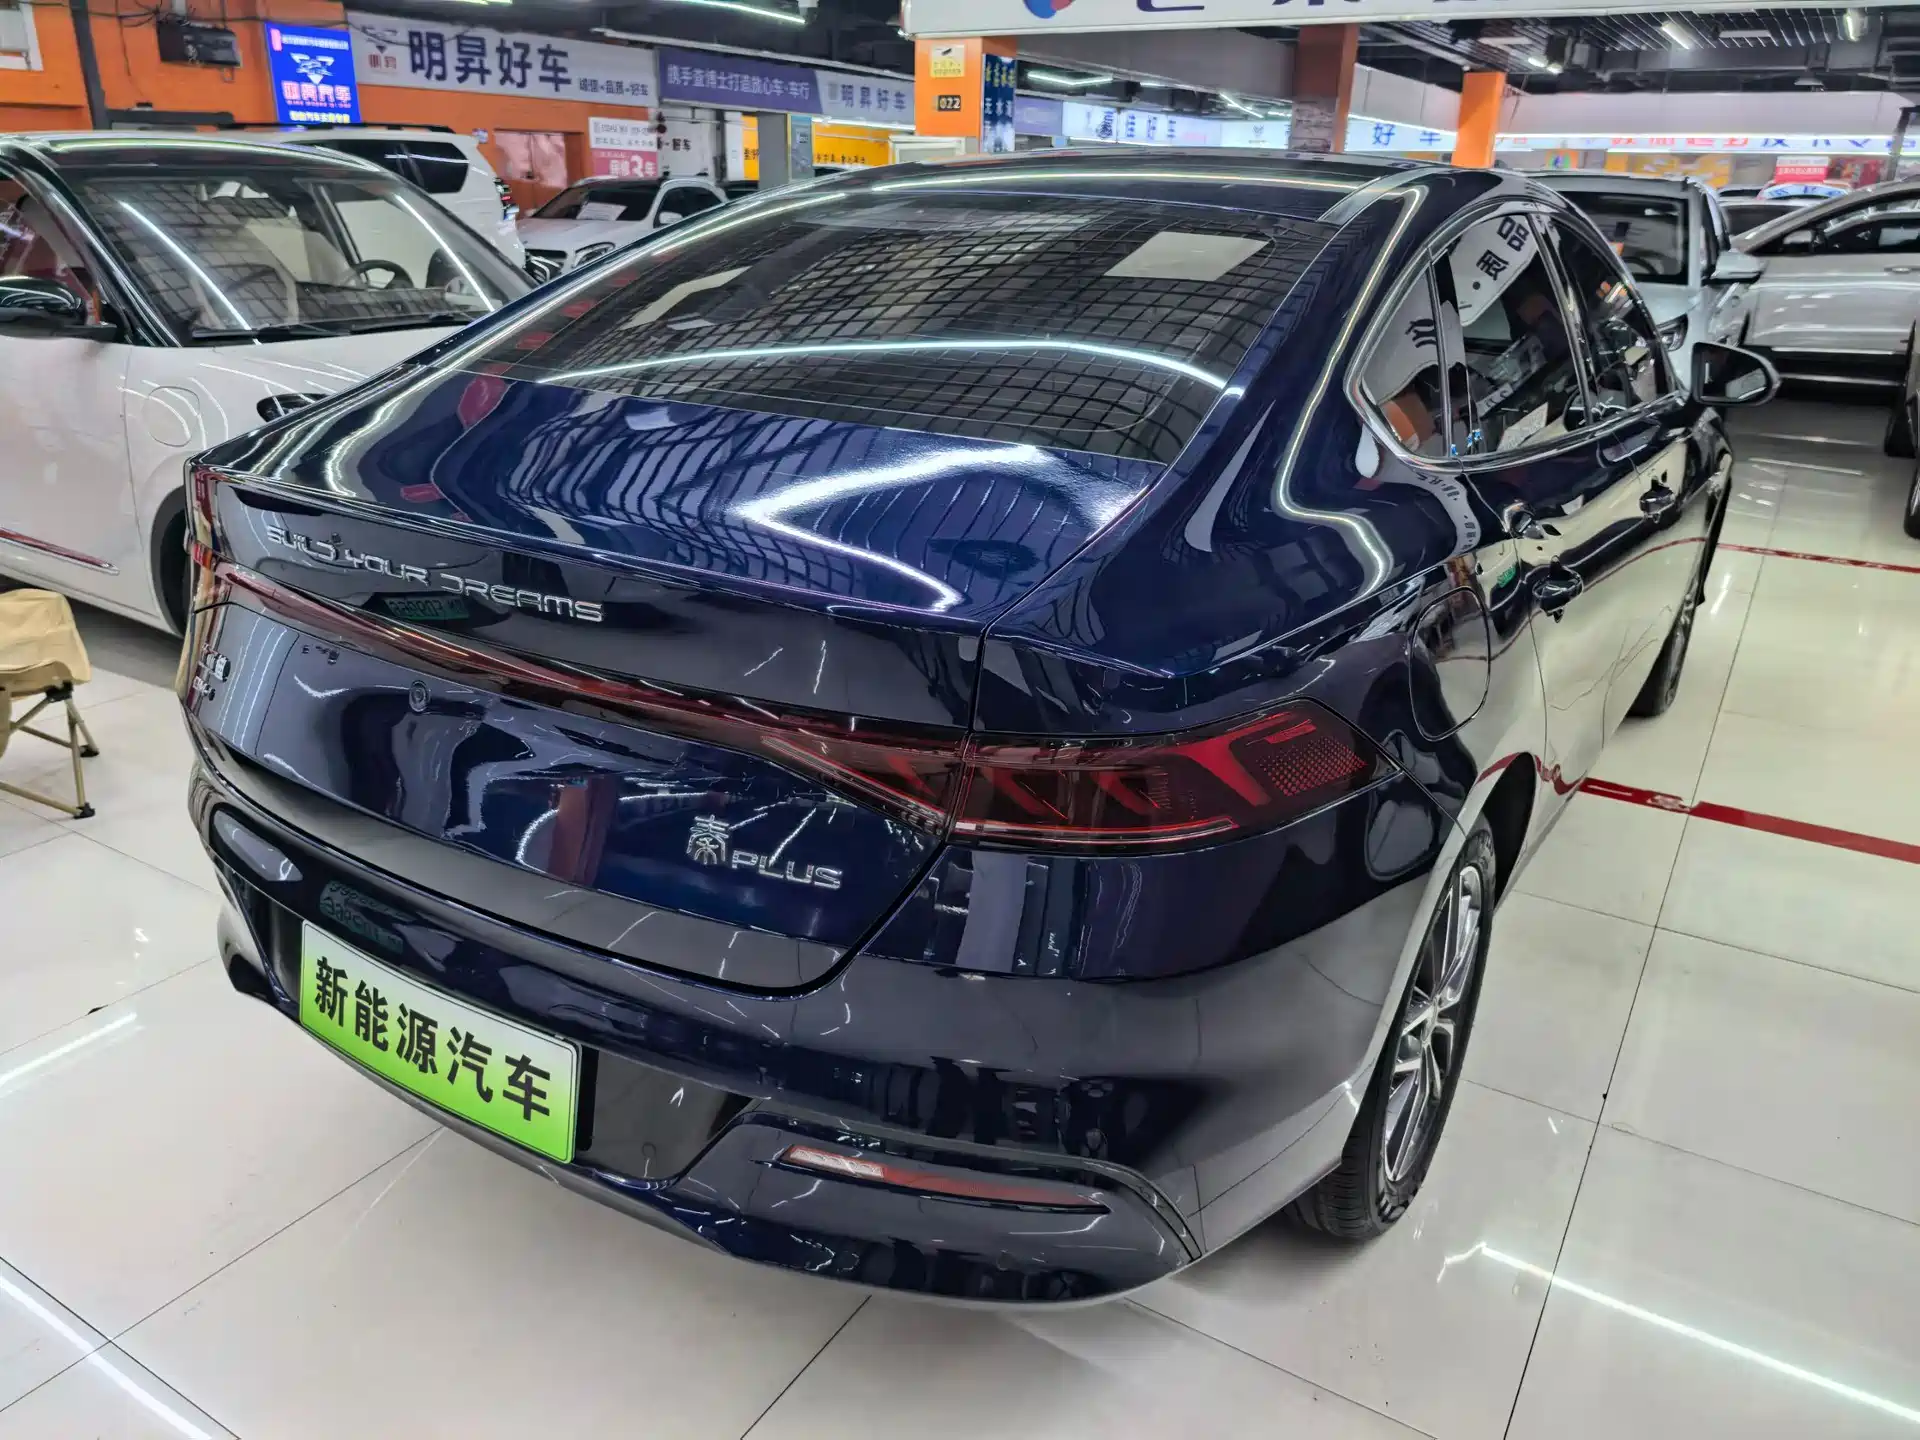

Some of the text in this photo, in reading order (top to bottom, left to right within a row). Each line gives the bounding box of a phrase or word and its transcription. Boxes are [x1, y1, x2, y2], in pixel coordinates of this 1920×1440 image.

[408, 30, 572, 92] 明昇好车
[939, 97, 961, 109] 022
[266, 525, 338, 562] BUILD
[345, 548, 431, 587] YOUR
[440, 572, 604, 623] DREAMS
[732, 849, 843, 890] PLUS
[314, 956, 551, 1121] 新能源汽车
